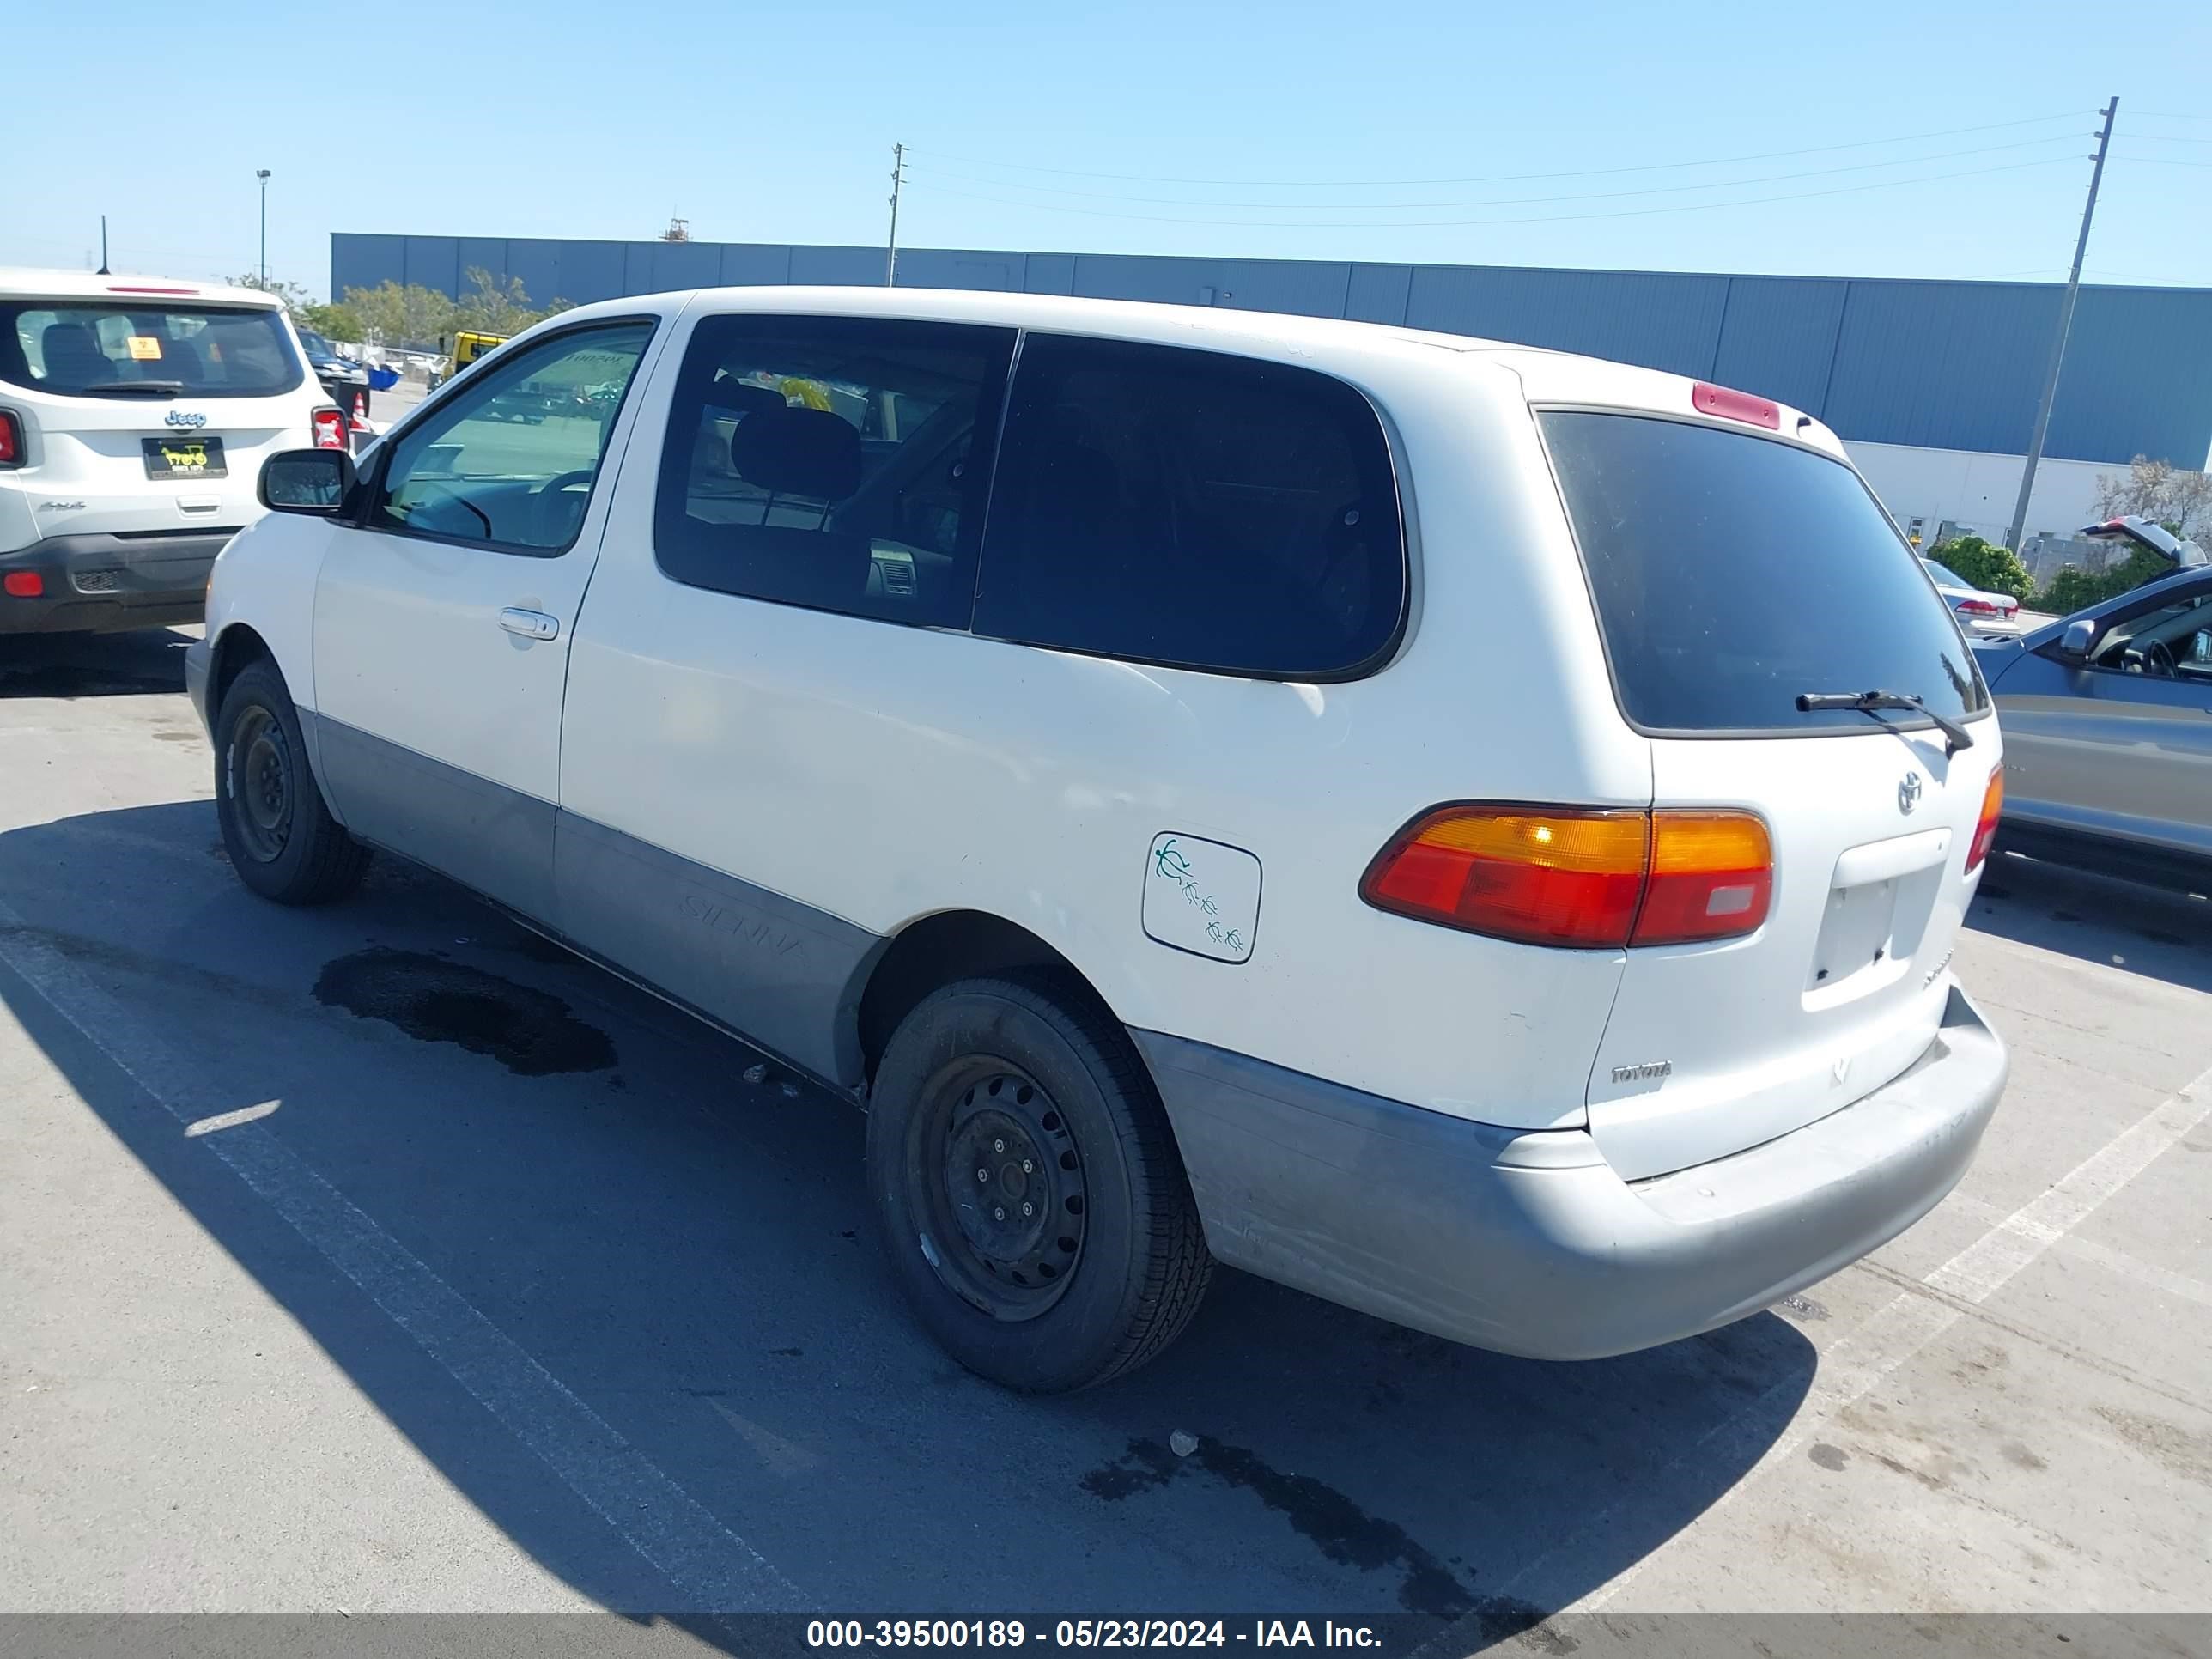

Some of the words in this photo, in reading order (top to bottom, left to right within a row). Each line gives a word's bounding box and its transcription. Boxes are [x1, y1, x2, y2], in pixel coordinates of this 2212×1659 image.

[164, 410, 207, 428] Jeep
[678, 895, 807, 961] SIENNA
[1611, 1060, 1673, 1084] TOYOTA
